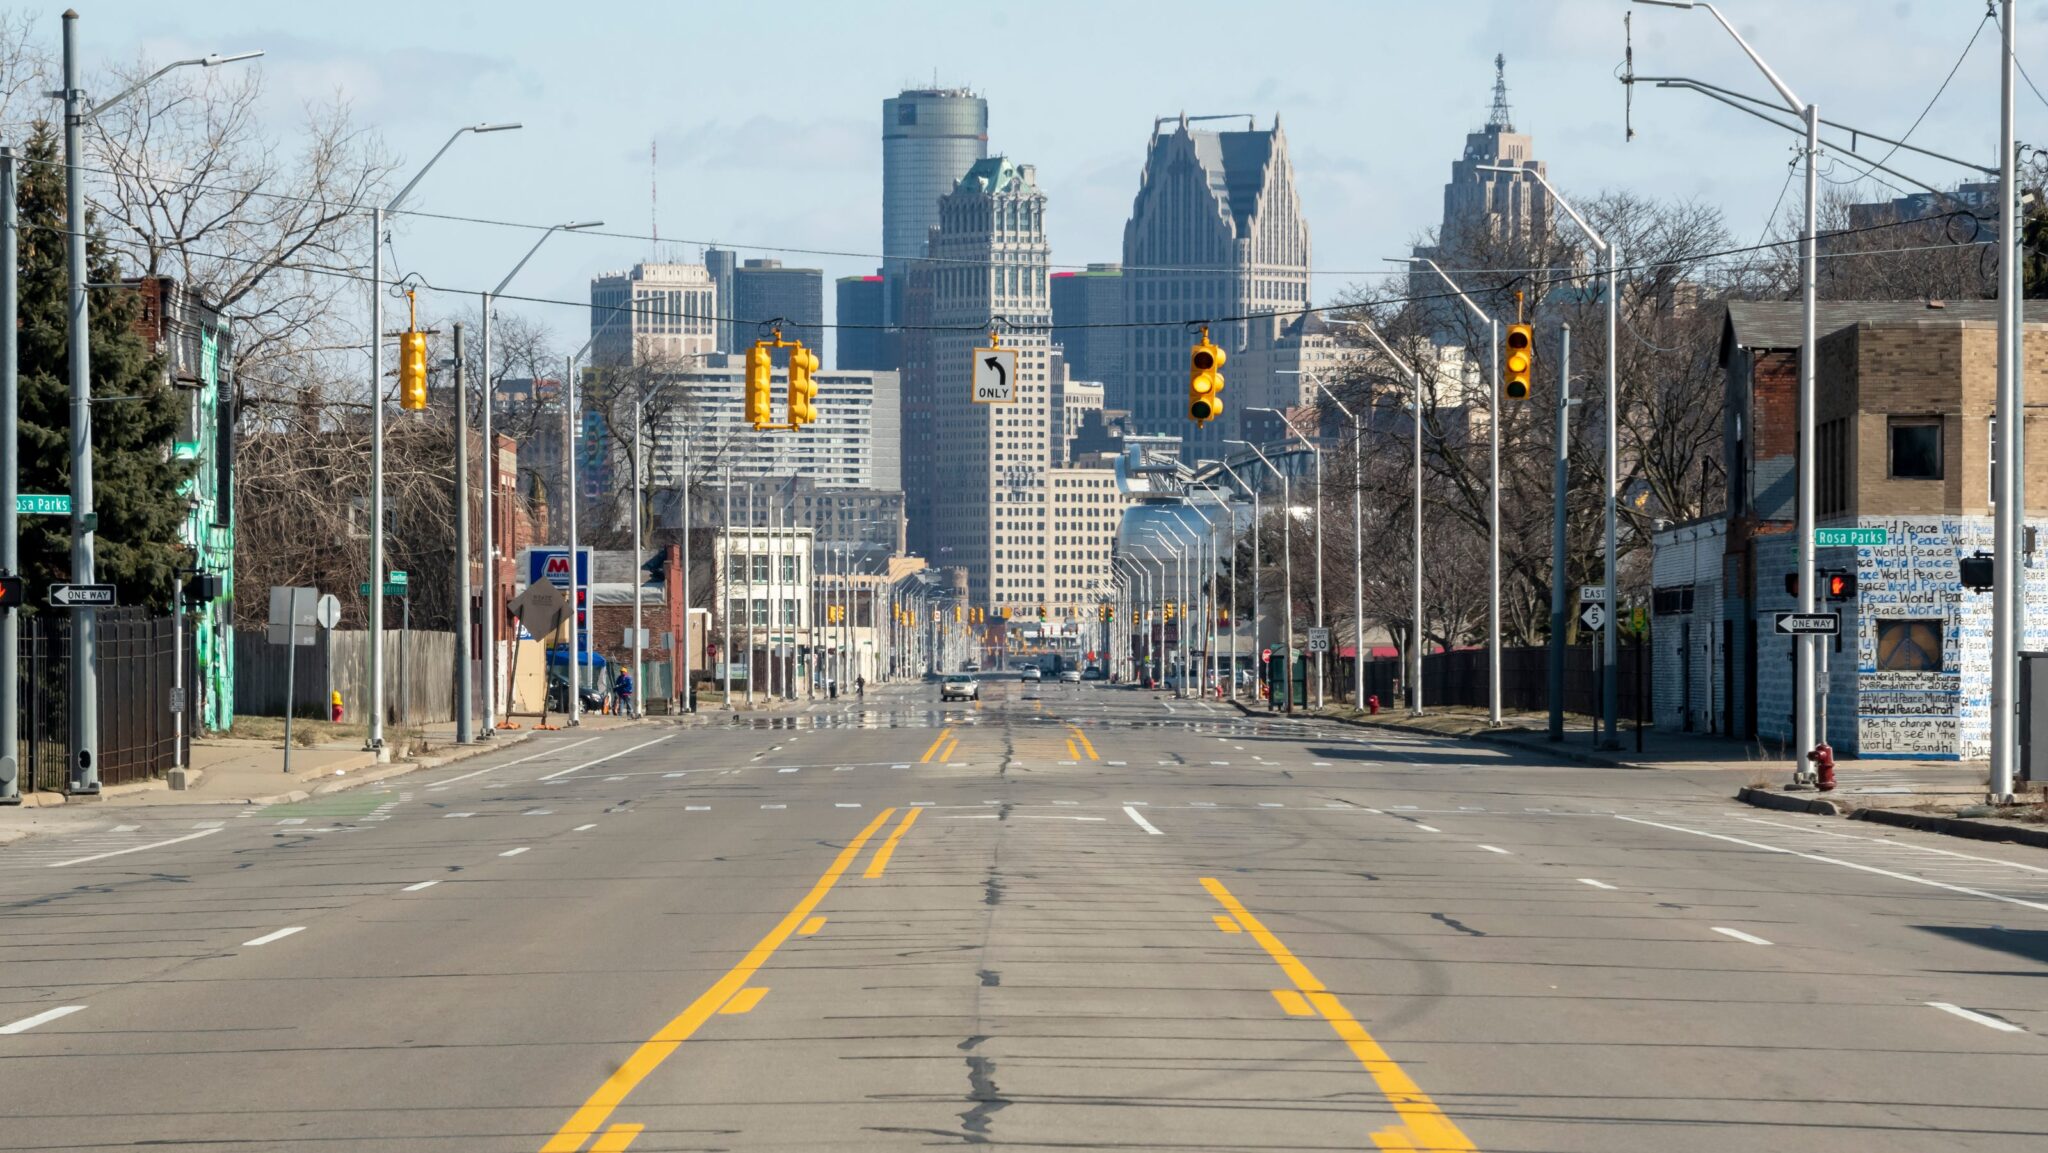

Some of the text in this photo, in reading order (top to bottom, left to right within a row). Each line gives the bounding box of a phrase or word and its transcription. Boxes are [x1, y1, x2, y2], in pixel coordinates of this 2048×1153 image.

[979, 387, 1009, 399] ONLY
[16, 498, 68, 511] osa Parks
[1903, 521, 1938, 534] Peace
[1820, 531, 1883, 543] Rosa Parks
[1887, 533, 1904, 545] rld
[1910, 531, 1948, 546] Peace
[1873, 546, 1908, 557] World
[1911, 546, 1952, 557] Peace
[1875, 556, 1908, 568] World
[1912, 556, 1953, 568] Peace
[1881, 568, 1910, 580] World
[1913, 569, 1957, 580] Peace
[1857, 578, 1963, 592] eace World Peace
[68, 591, 109, 600] ONE WAY
[1585, 589, 1606, 598] EAST
[1861, 591, 1897, 603] Peace
[1900, 591, 1934, 603] World
[1867, 603, 1905, 615] Peace
[1907, 604, 1942, 615] World
[1592, 613, 1598, 624] 5
[1792, 619, 1832, 628] ONE WAY
[1311, 640, 1326, 649] 30
[1881, 717, 1896, 728] the
[1899, 717, 1932, 731] change
[1935, 721, 1956, 733] you
[1890, 728, 1902, 739] to
[1904, 731, 1924, 739] see
[1927, 730, 1936, 739] in
[1939, 729, 1956, 740] the
